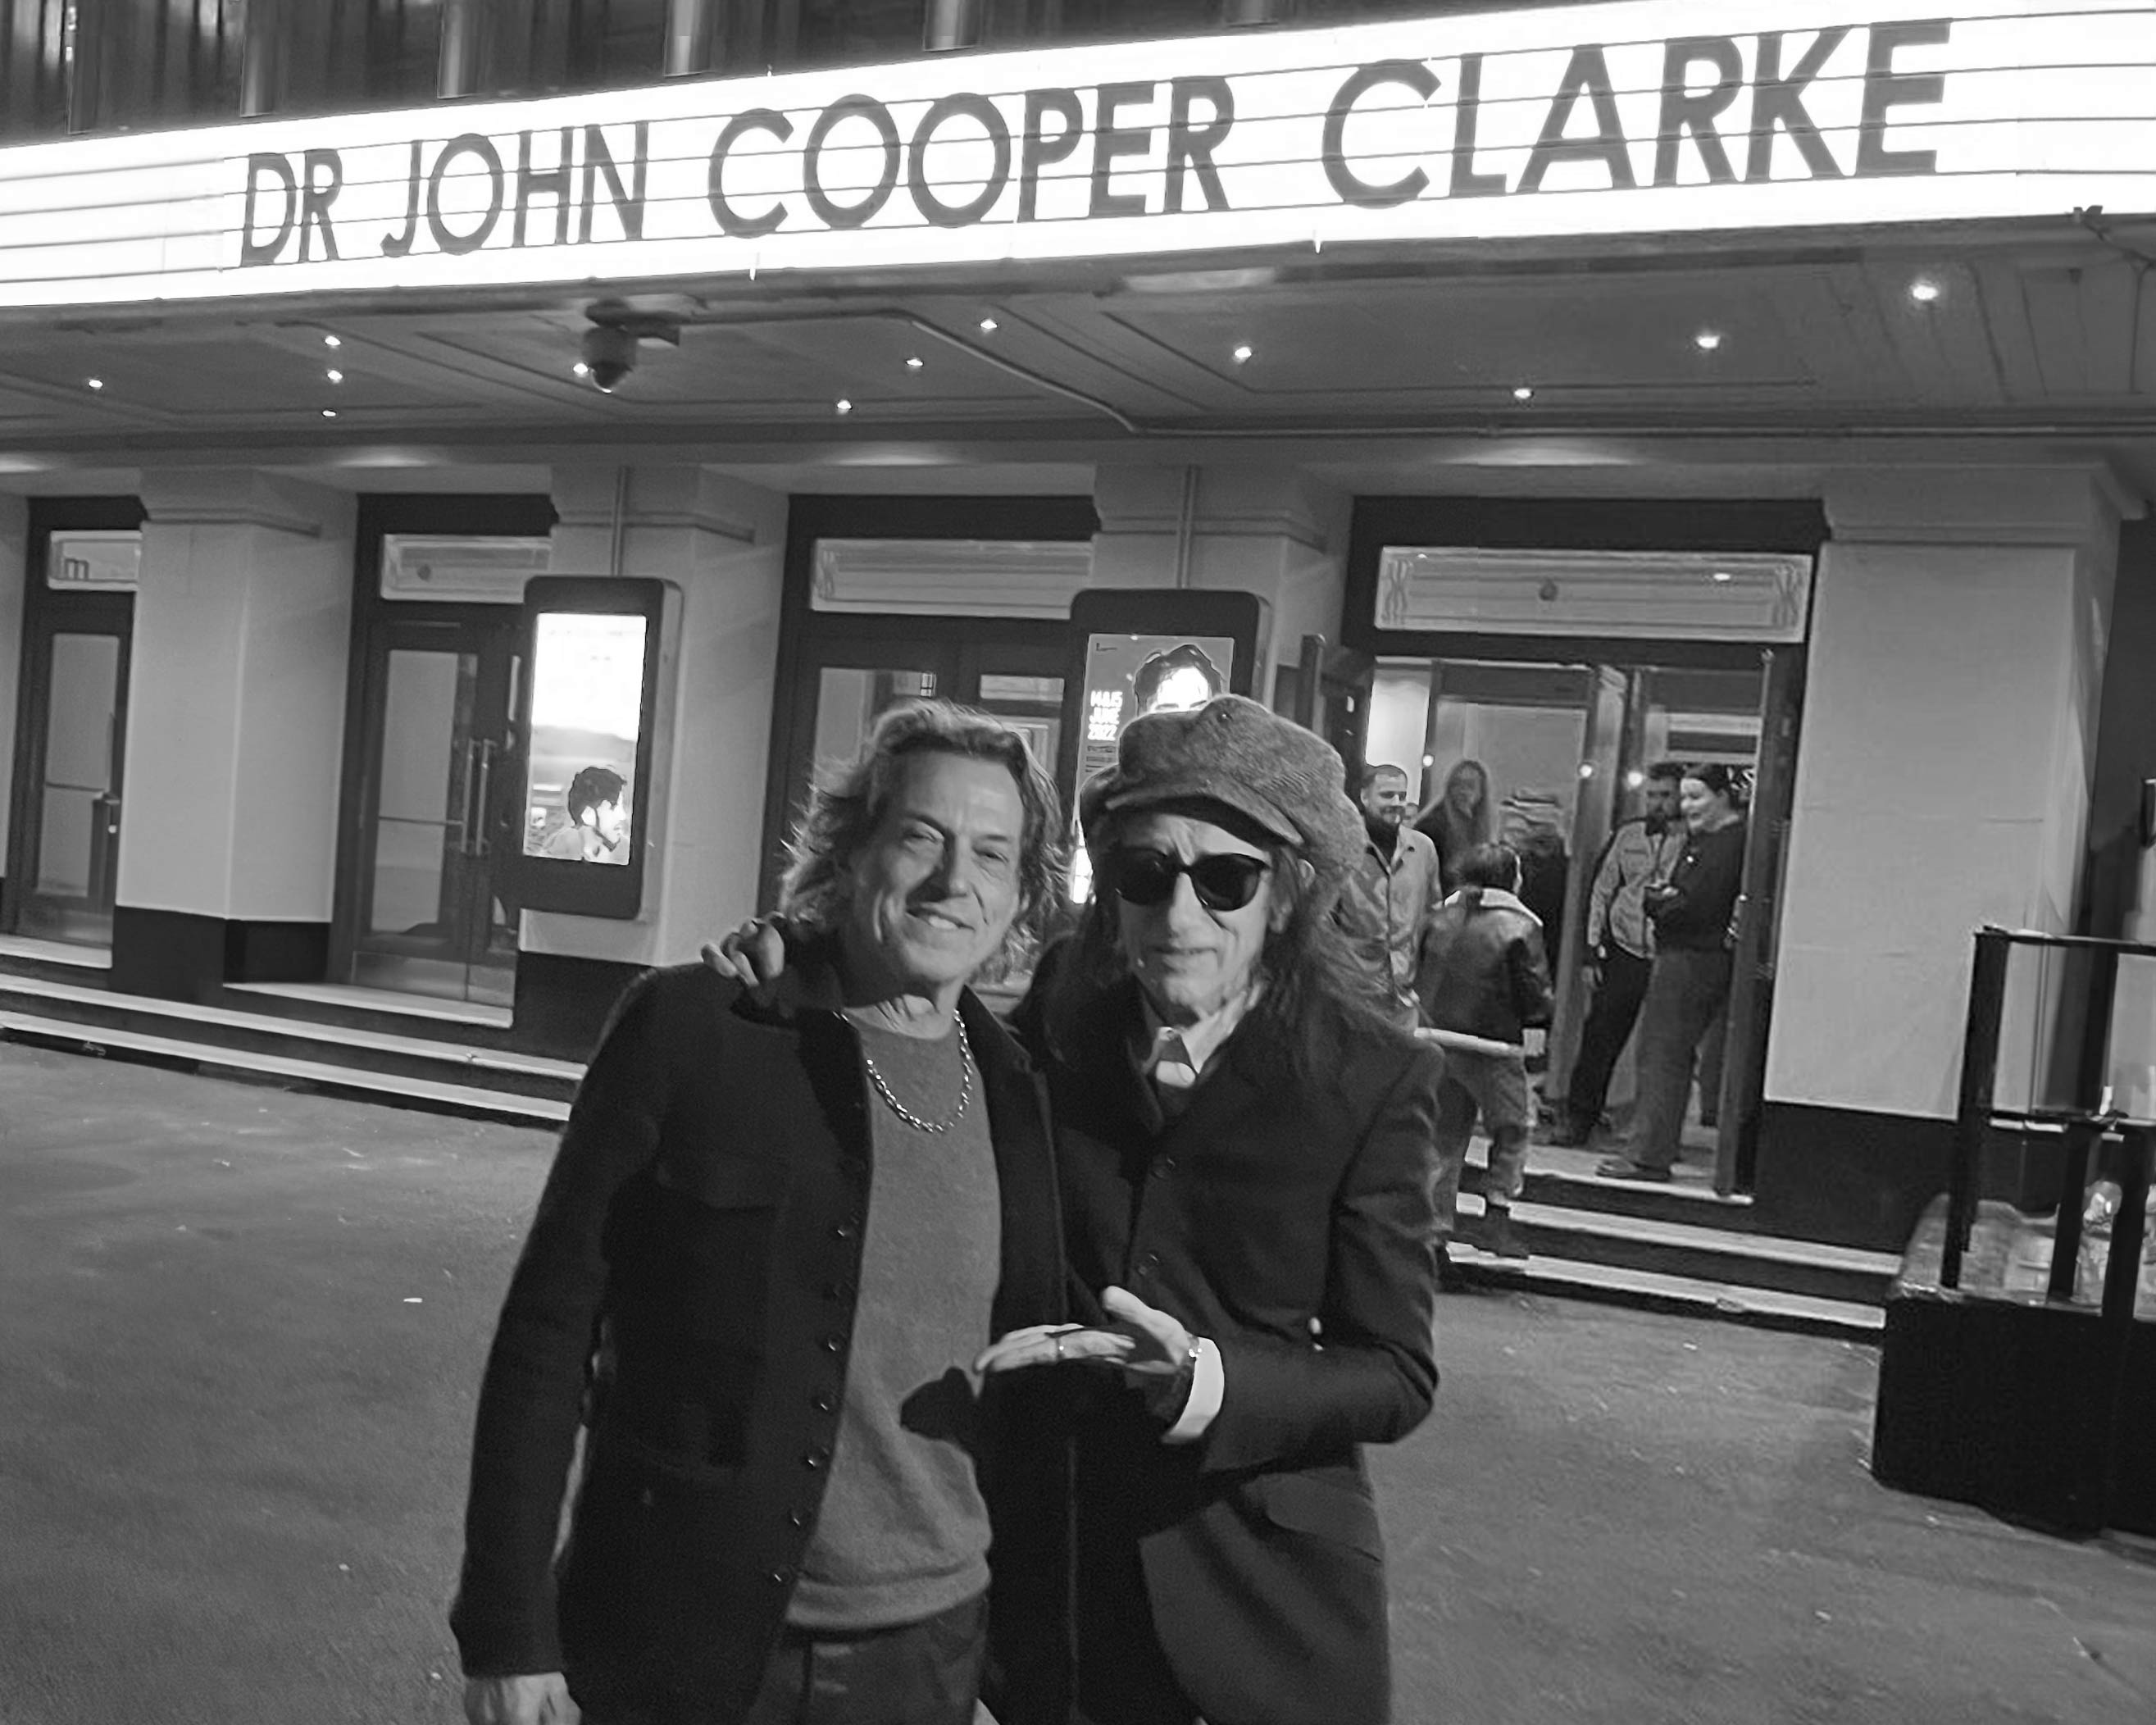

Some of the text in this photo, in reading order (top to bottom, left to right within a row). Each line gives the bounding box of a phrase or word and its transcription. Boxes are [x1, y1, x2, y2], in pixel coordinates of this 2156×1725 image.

[240, 18, 1952, 266] DR JOHN COOPER CLARKE
